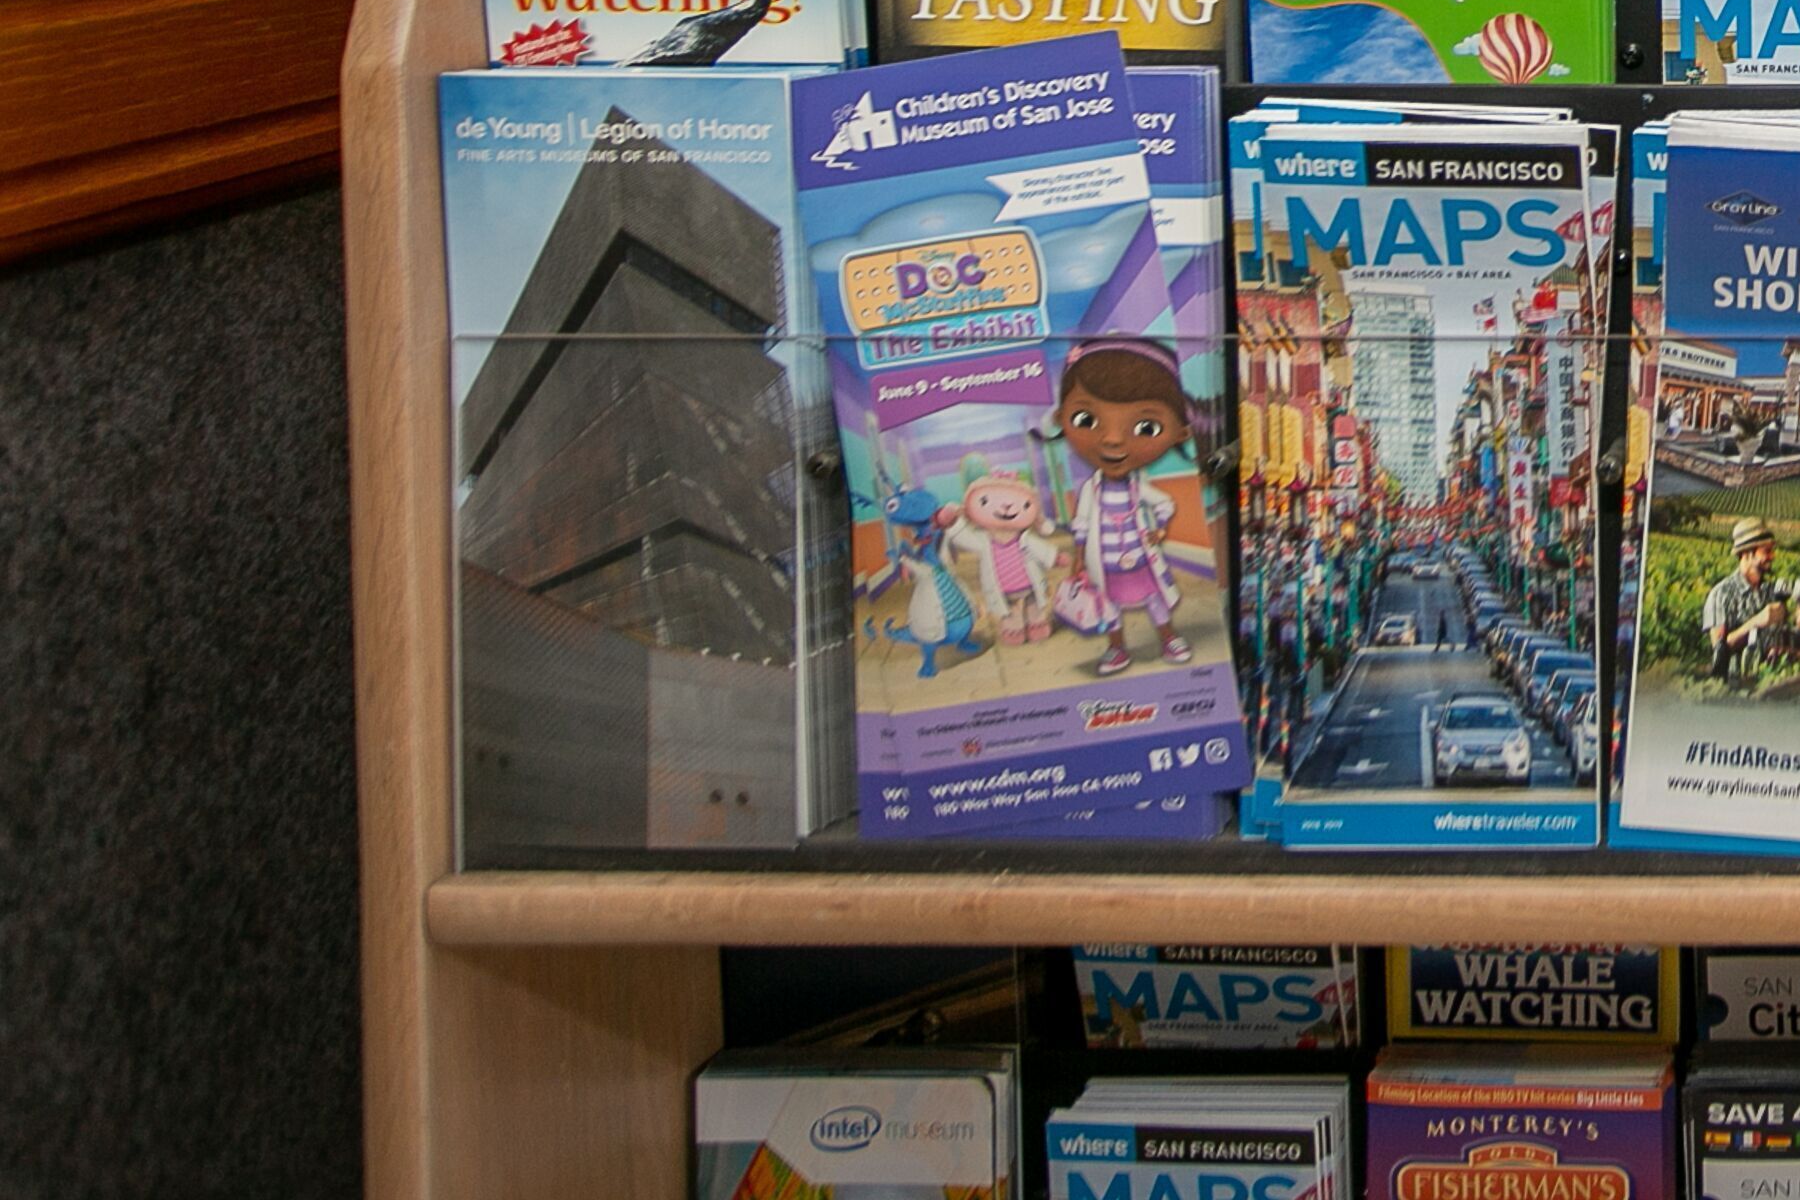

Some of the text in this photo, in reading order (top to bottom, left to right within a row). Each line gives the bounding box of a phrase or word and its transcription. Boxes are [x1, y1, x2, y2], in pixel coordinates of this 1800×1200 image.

[1454, 954, 1615, 989] WHALE
[1744, 977, 1792, 997] SAN
[1091, 970, 1323, 1022] MAPS
[1416, 991, 1652, 1027] WATCHING
